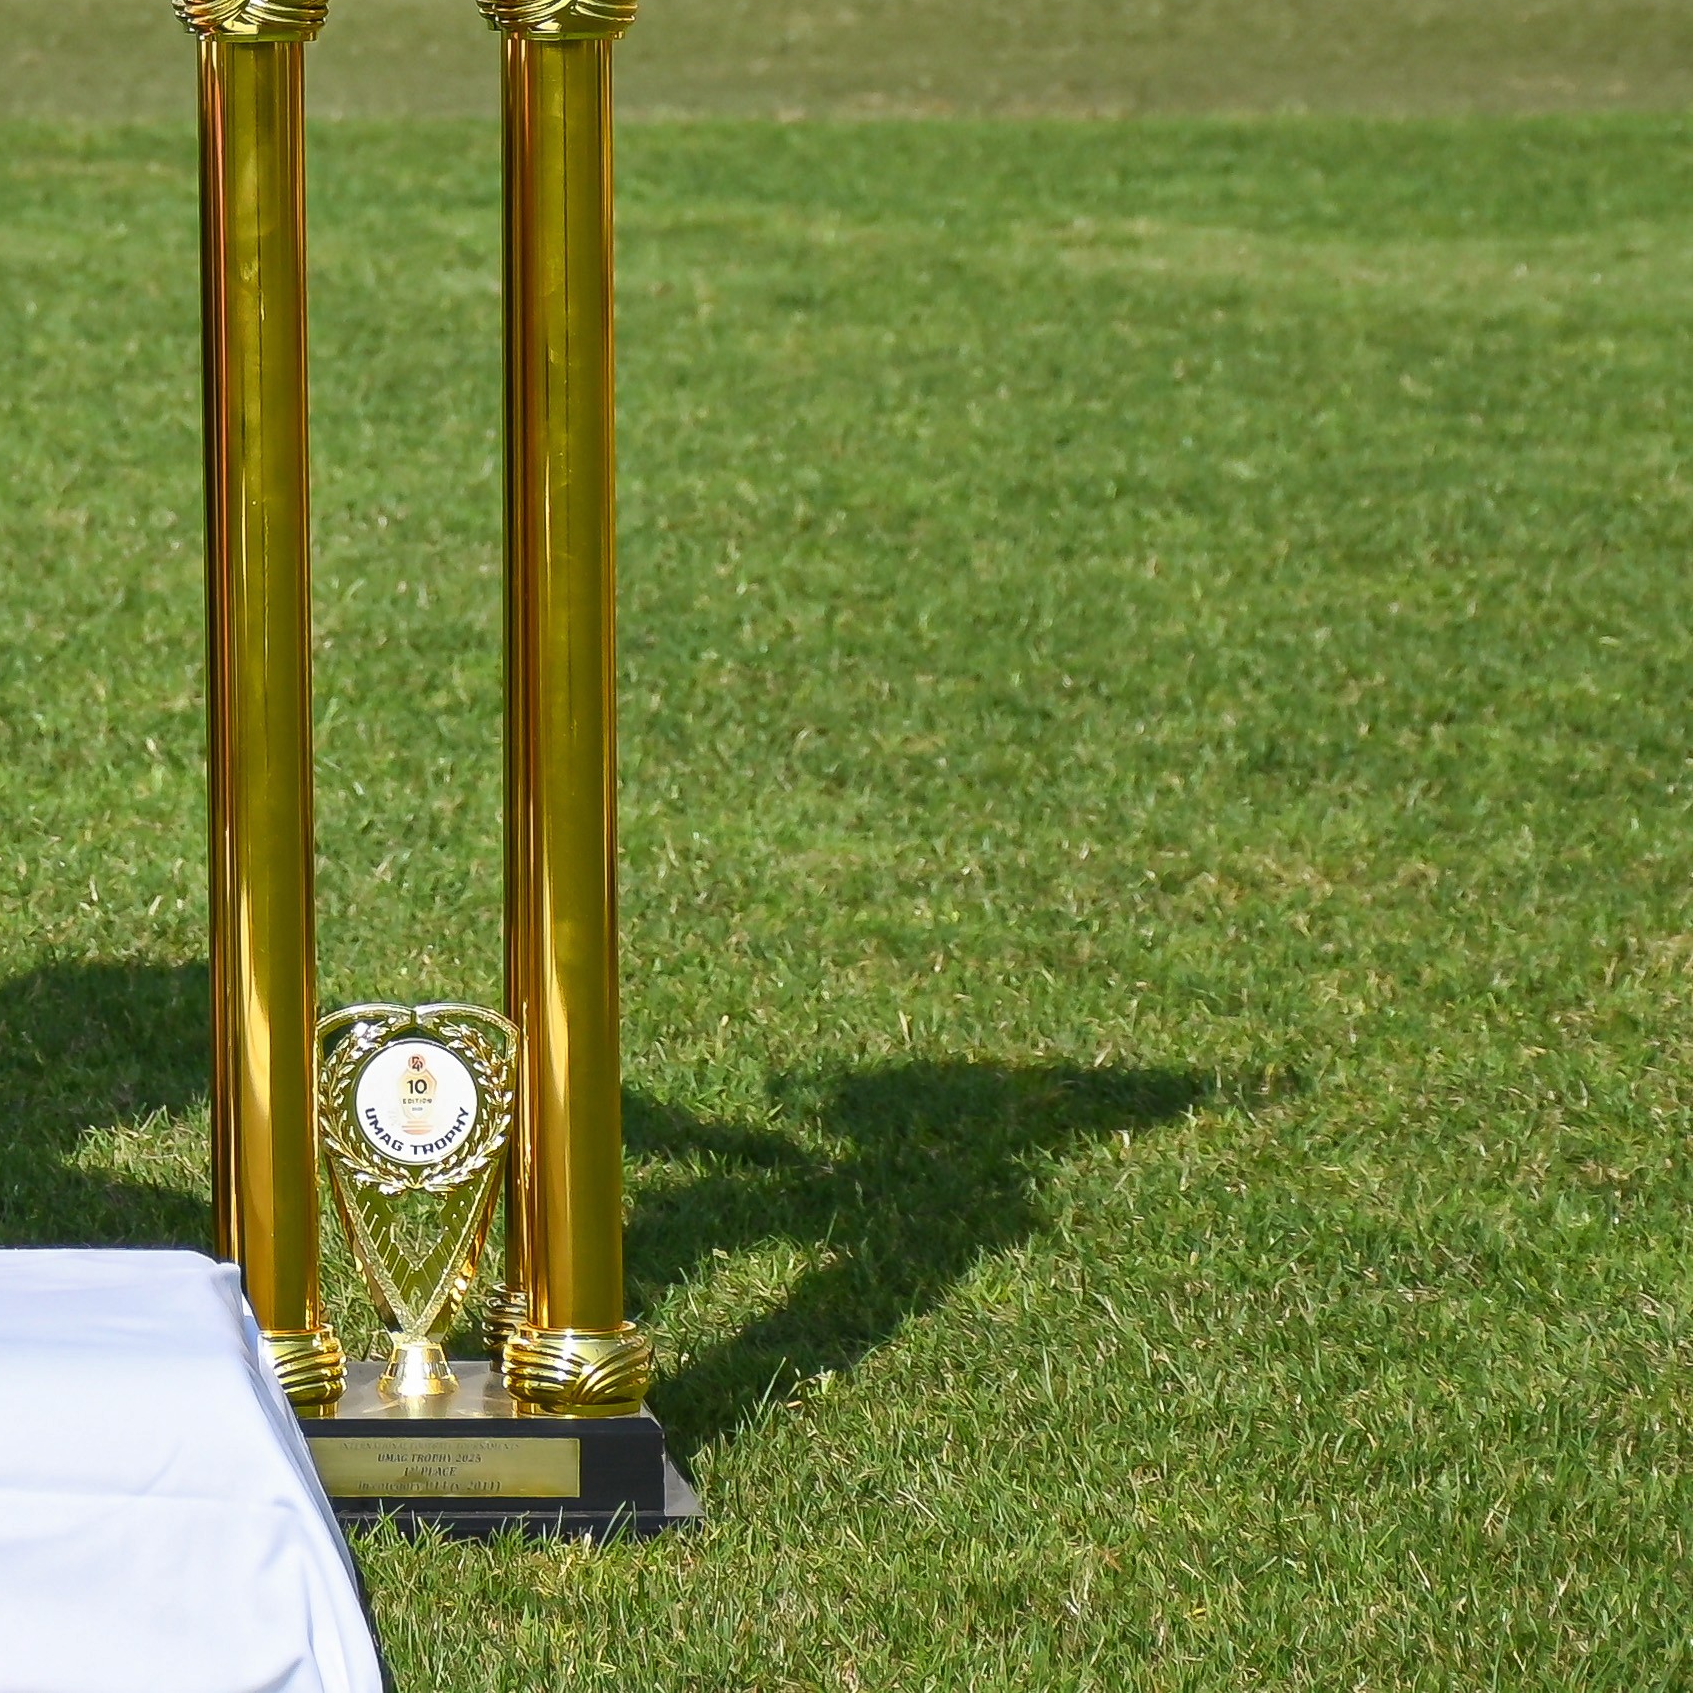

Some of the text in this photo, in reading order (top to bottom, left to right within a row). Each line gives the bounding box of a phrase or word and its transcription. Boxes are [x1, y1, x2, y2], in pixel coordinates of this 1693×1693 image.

[407, 1079, 428, 1095] 10
[365, 1107, 469, 1155] UMAG TROPHY
[377, 1453, 409, 1463] UMAG
